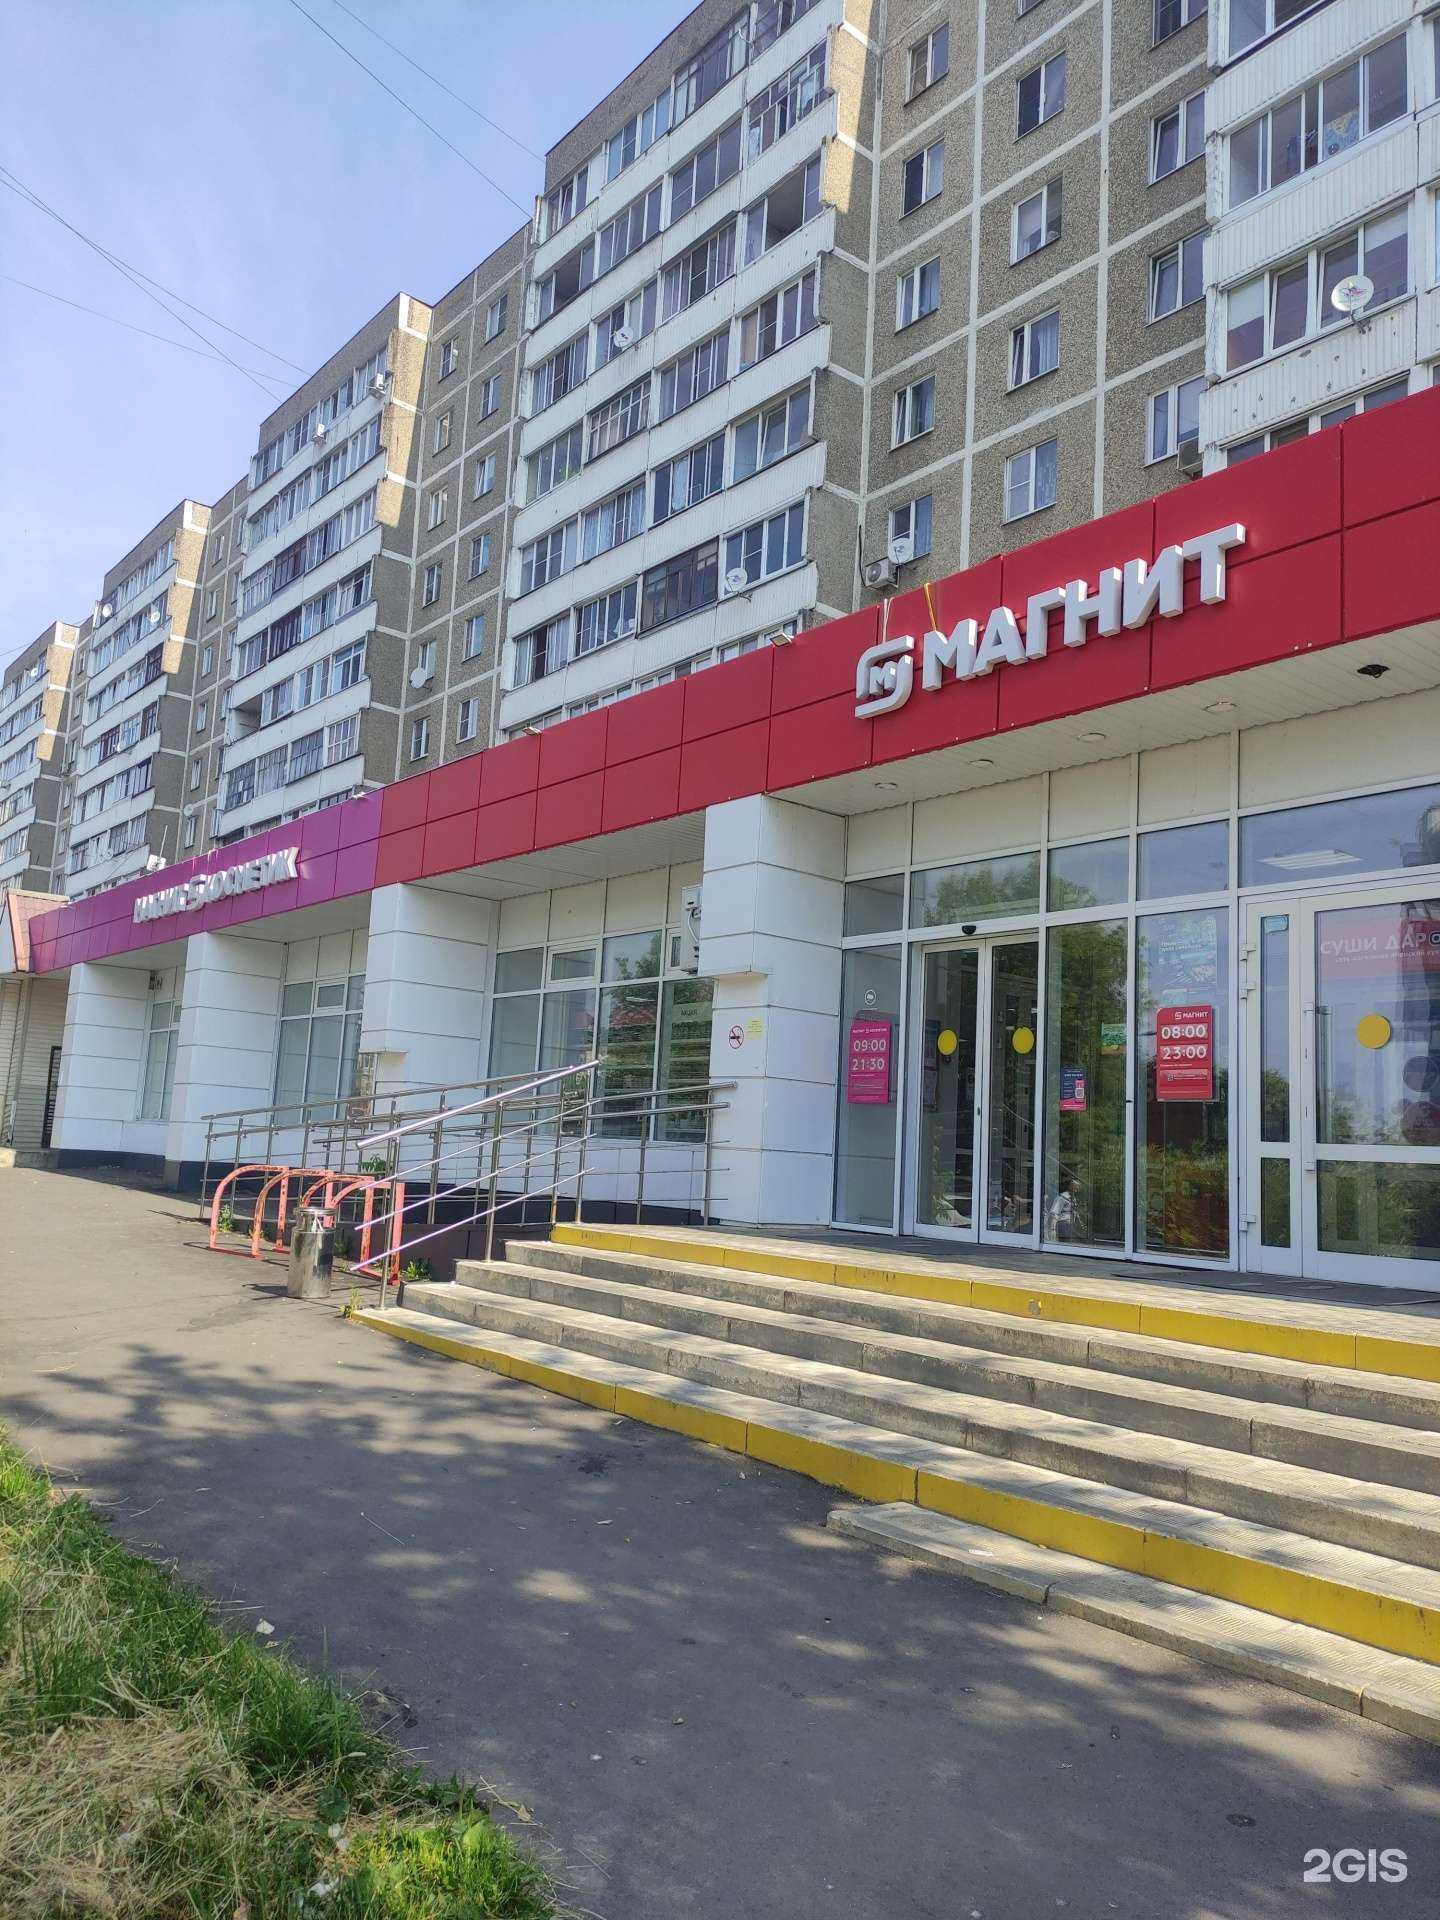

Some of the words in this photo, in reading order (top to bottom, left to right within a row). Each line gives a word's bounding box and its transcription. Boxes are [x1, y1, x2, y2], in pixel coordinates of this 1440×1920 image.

[922, 522, 1246, 691] МАГНИТ
[1320, 937, 1377, 956] СУШИ
[1182, 1011, 1209, 1019] МАГНИТ
[1161, 1024, 1206, 1039] 08:00
[853, 1039, 886, 1052] 09:00
[1162, 1045, 1207, 1060] 23:00
[852, 1058, 885, 1071] 21:30
